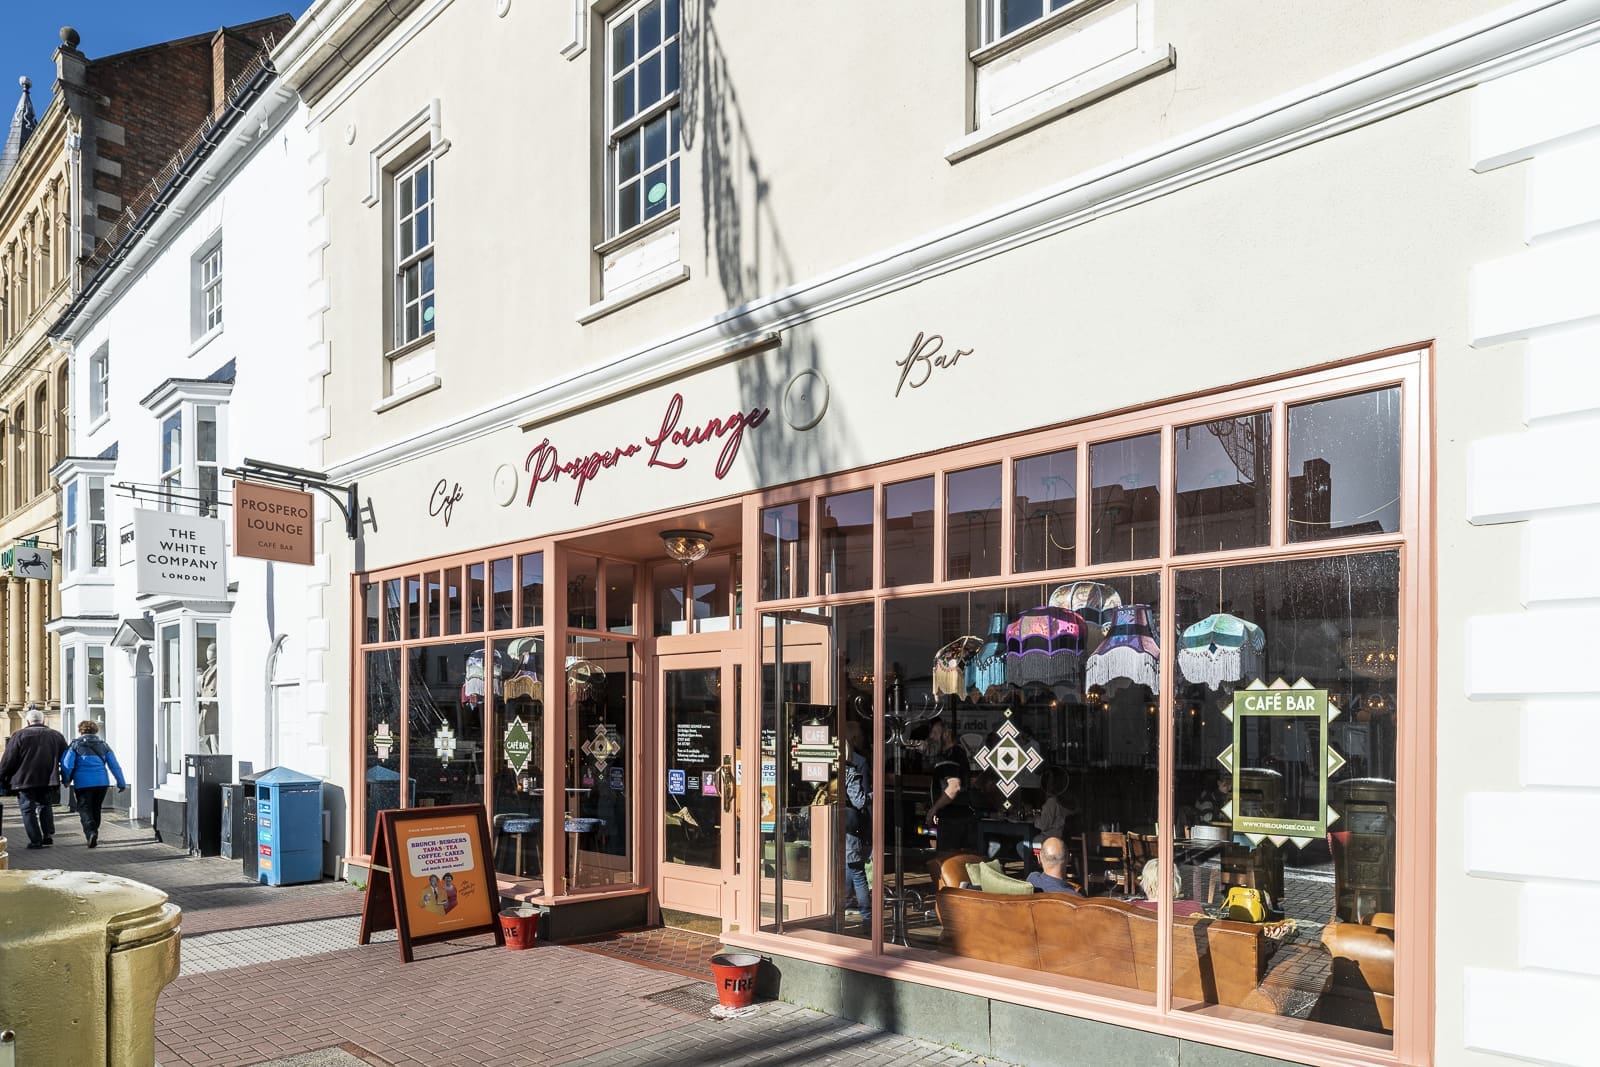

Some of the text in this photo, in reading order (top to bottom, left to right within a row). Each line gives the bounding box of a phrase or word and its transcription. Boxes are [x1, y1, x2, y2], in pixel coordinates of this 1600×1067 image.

[895, 331, 974, 398] Bar
[525, 393, 770, 508] Prospero Lounge
[241, 498, 308, 518] PROSPERO
[429, 478, 464, 528] Café
[247, 518, 303, 535] LOUNGE
[168, 528, 196, 540] THE
[160, 541, 206, 555] WHITE
[279, 543, 293, 551] BAR
[146, 553, 218, 570] COMPANY
[161, 571, 206, 582] LONDON
[1244, 692, 1315, 711] CAFÉ BAR
[519, 741, 529, 750] BAR
[807, 766, 823, 777] BAR
[417, 849, 465, 860] COFFEE CAKES
[425, 856, 459, 865] COCKTAILS
[724, 978, 753, 992] FIRE
